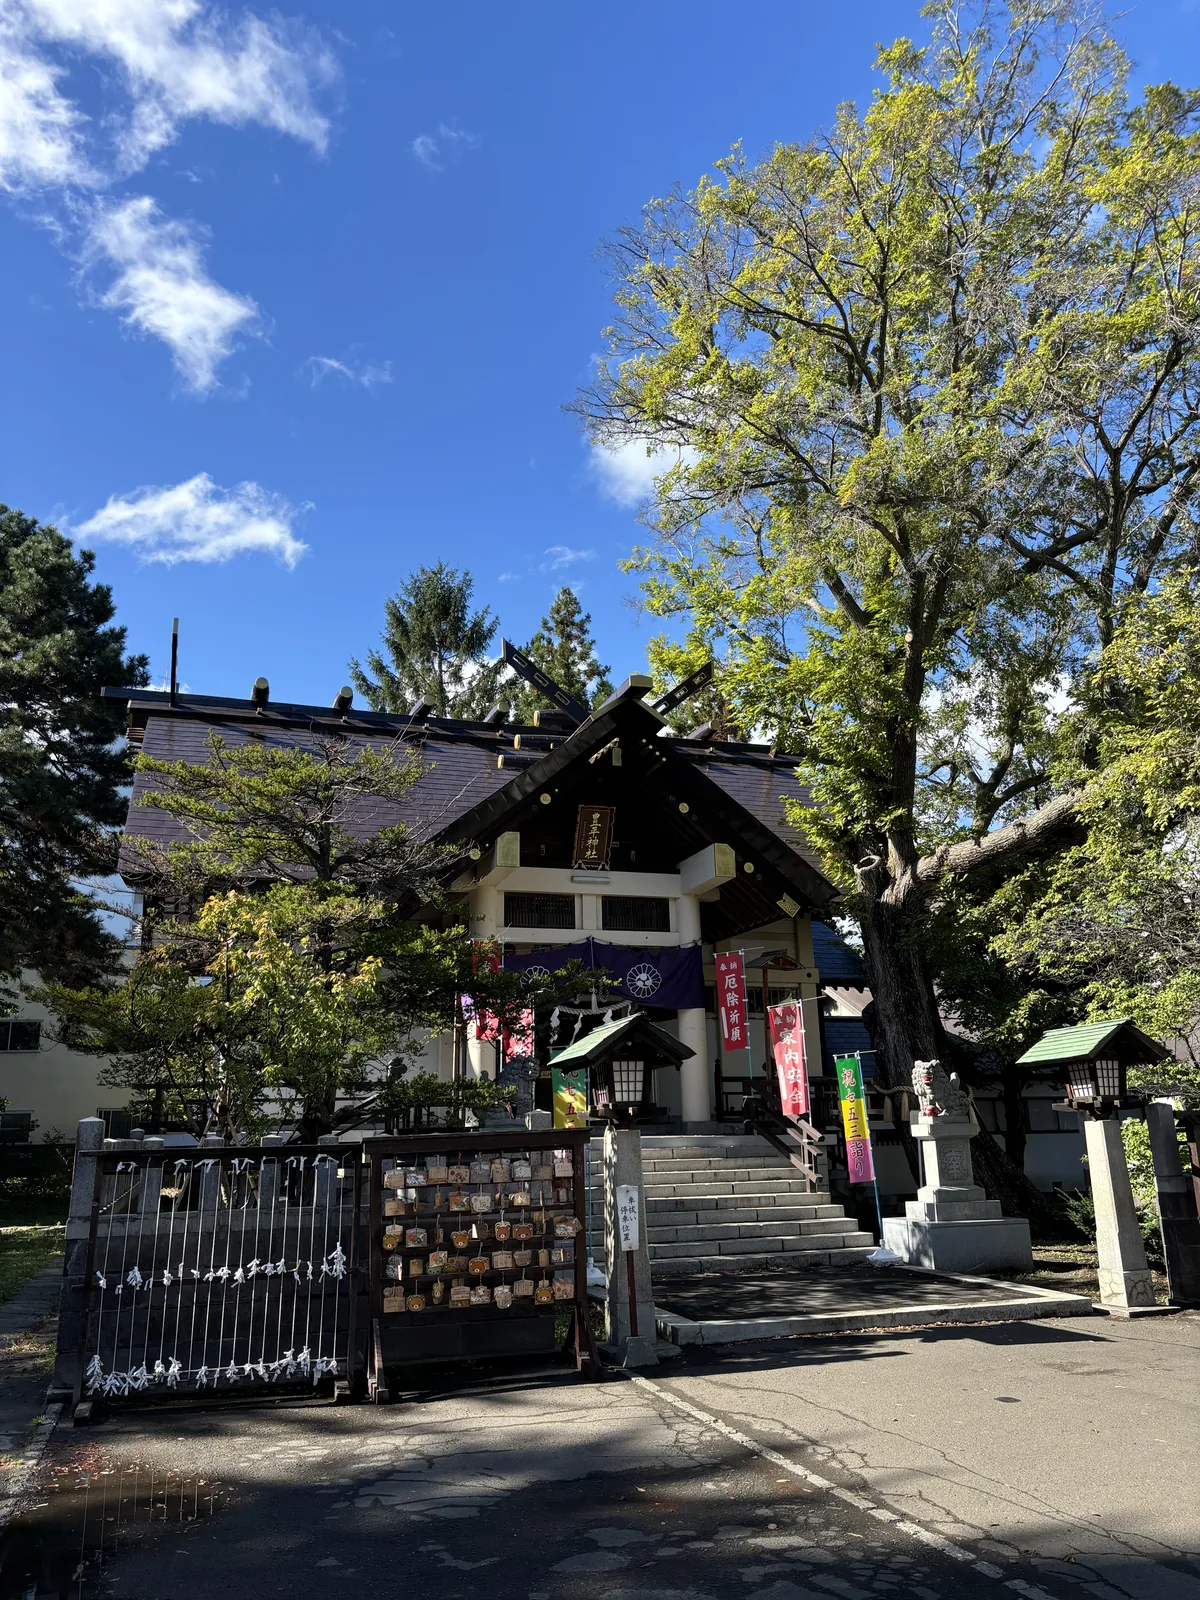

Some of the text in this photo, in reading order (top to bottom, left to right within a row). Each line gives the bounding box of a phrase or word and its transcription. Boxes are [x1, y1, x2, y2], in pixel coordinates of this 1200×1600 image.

[719, 961, 738, 971] 奉納
[724, 973, 741, 1042] 厄除祈願
[773, 1014, 796, 1026] 奉納
[779, 1028, 804, 1104] 家内安全
[841, 1067, 864, 1177] 祝七五三詣り
[620, 1206, 631, 1242] 停車位置
[628, 1196, 637, 1221] 車祓い
